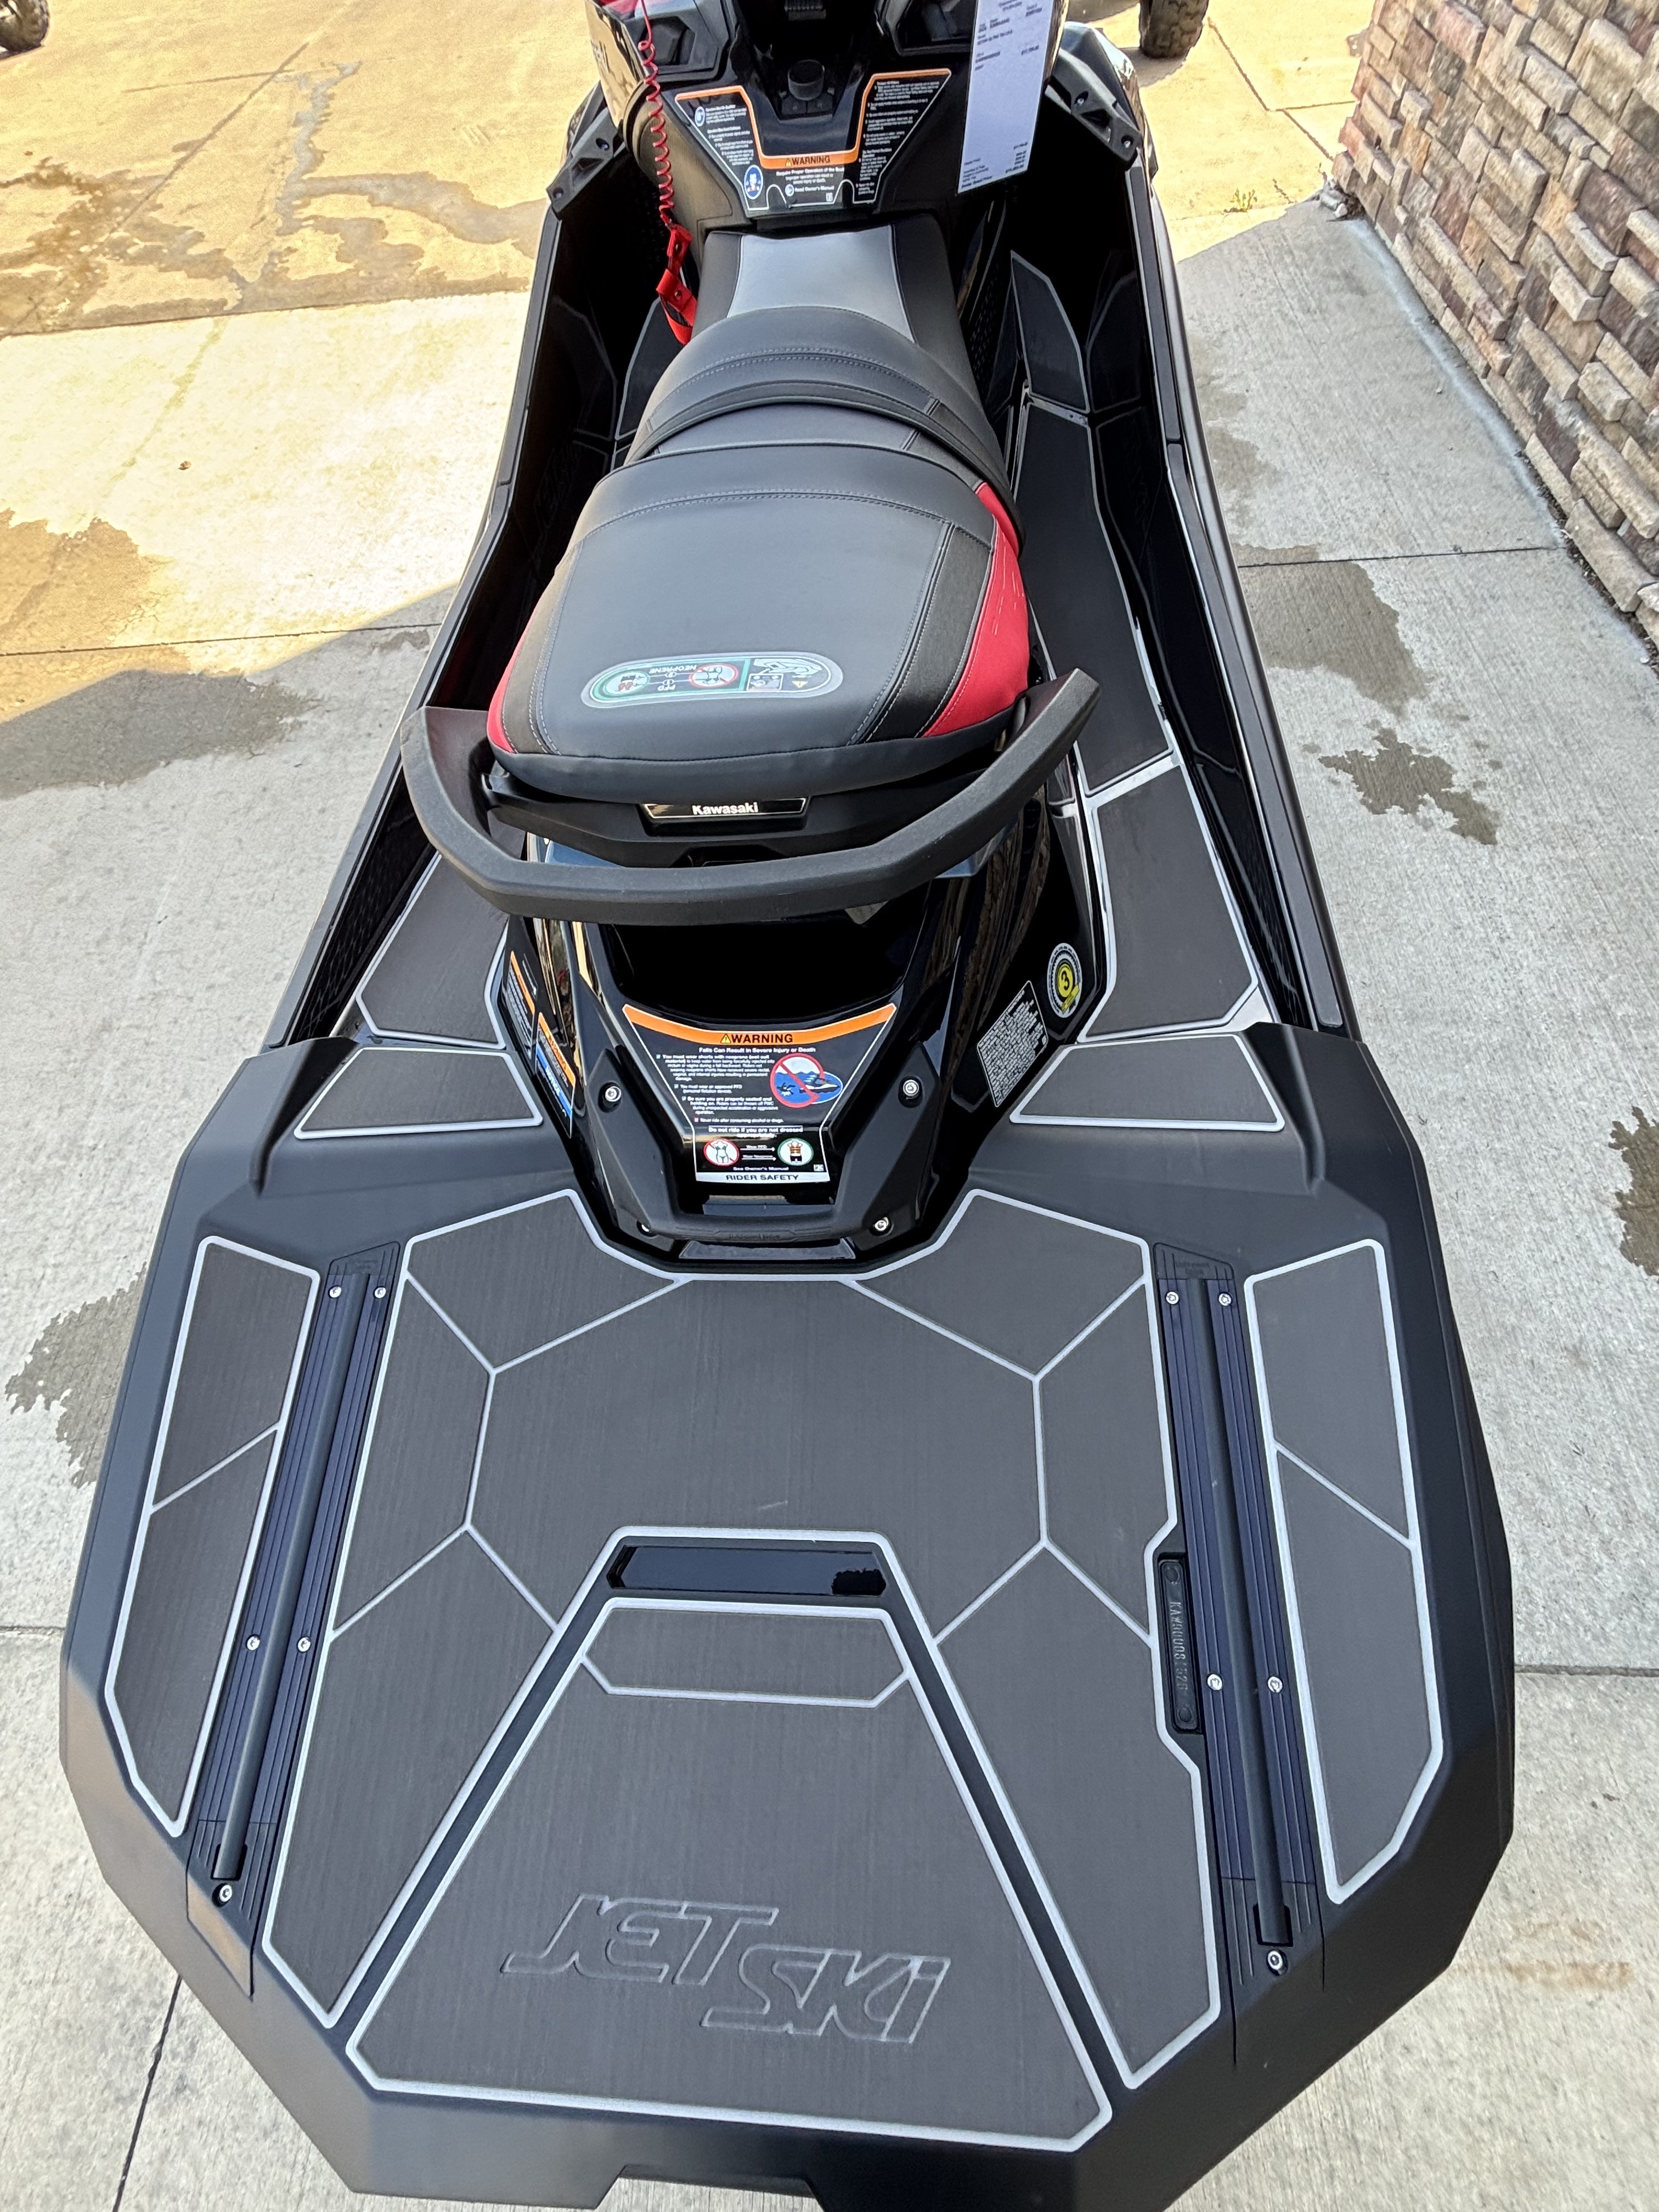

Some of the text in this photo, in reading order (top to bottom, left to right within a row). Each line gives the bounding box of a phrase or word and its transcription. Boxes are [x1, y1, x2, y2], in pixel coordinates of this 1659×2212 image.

[792, 155, 831, 165] WARNING
[648, 664, 697, 674] NEOPRENE
[692, 802, 759, 815] Kawasaki
[1061, 970, 1070, 991] 3
[731, 1034, 793, 1043] WARNING
[500, 1893, 951, 2044] JET SKI
